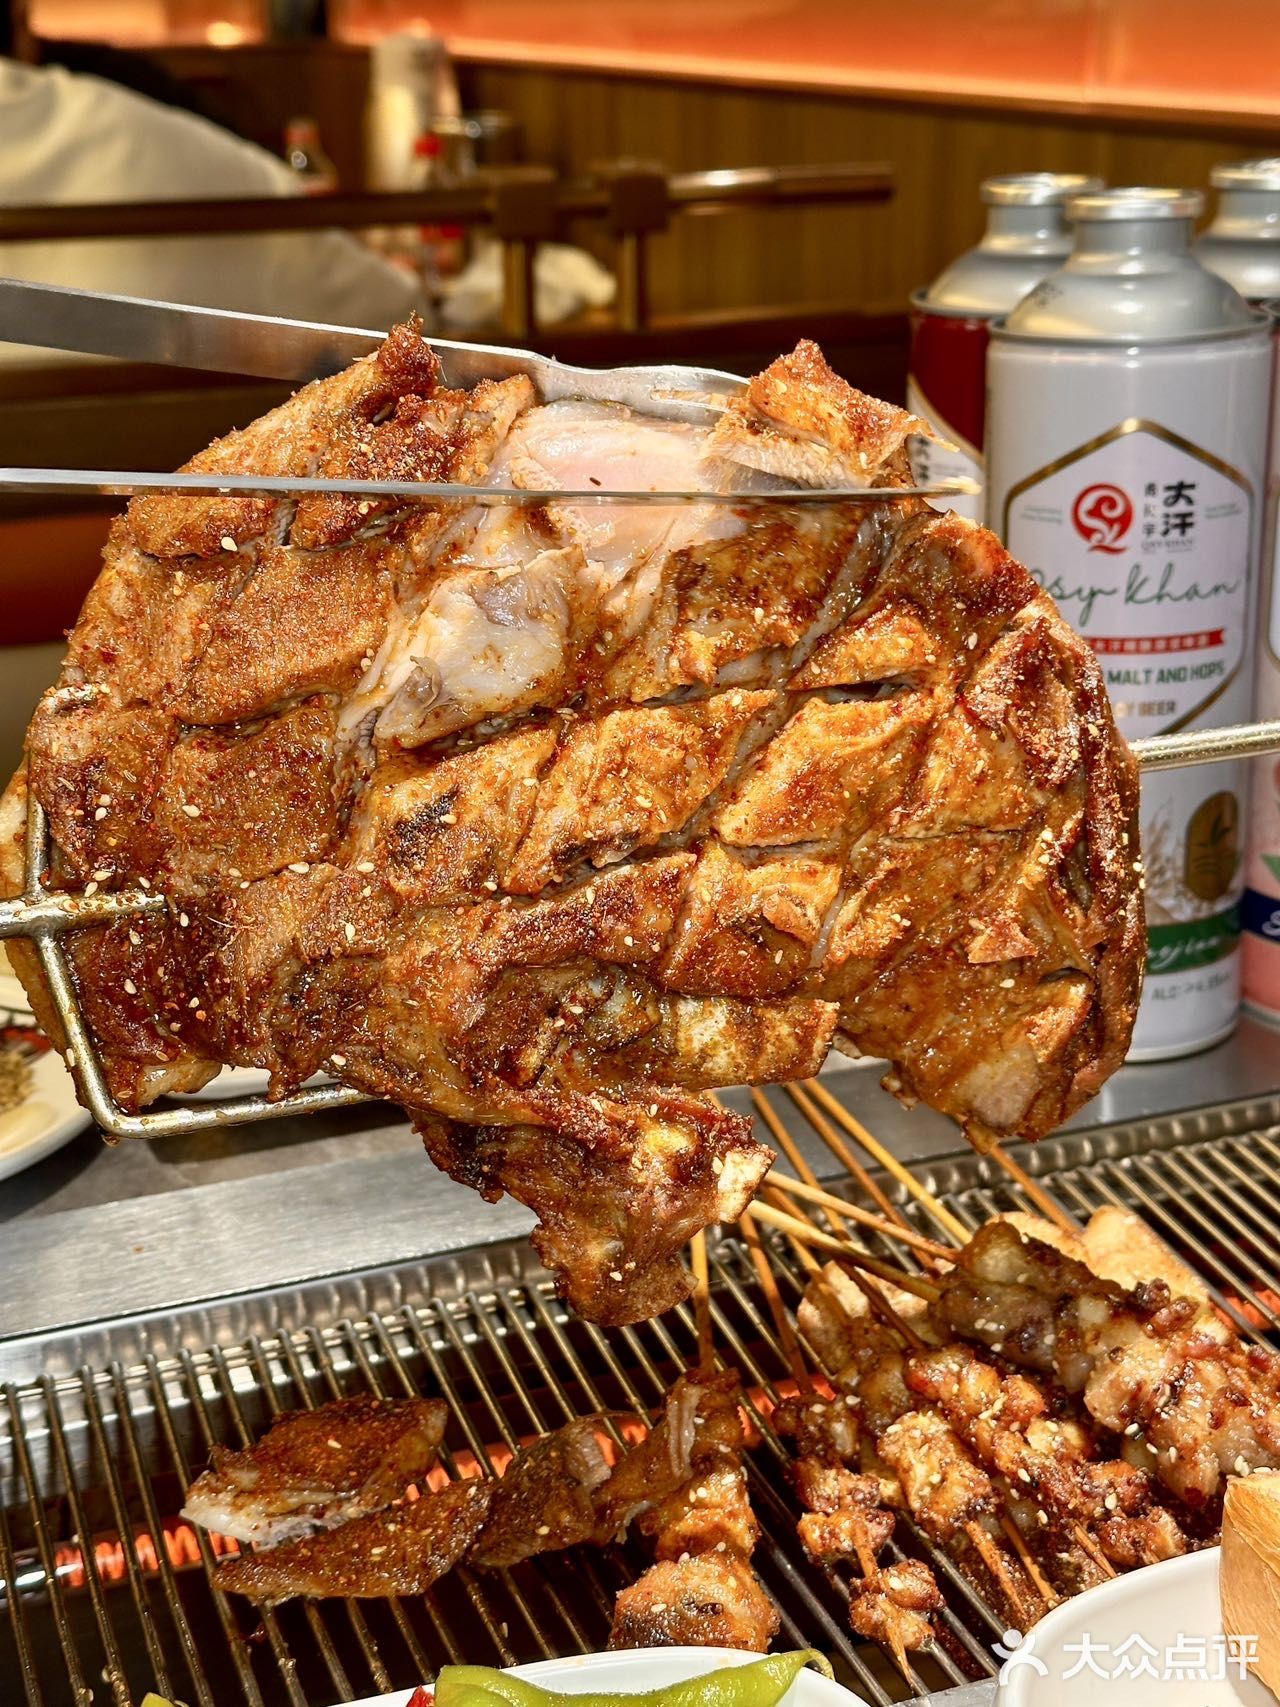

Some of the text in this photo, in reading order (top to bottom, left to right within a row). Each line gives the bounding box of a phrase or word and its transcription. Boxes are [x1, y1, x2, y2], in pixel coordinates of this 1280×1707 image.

[1162, 481, 1196, 537] 大汗
[1108, 660, 1225, 685] MALT AND HOPS
[1138, 701, 1176, 717] BEER
